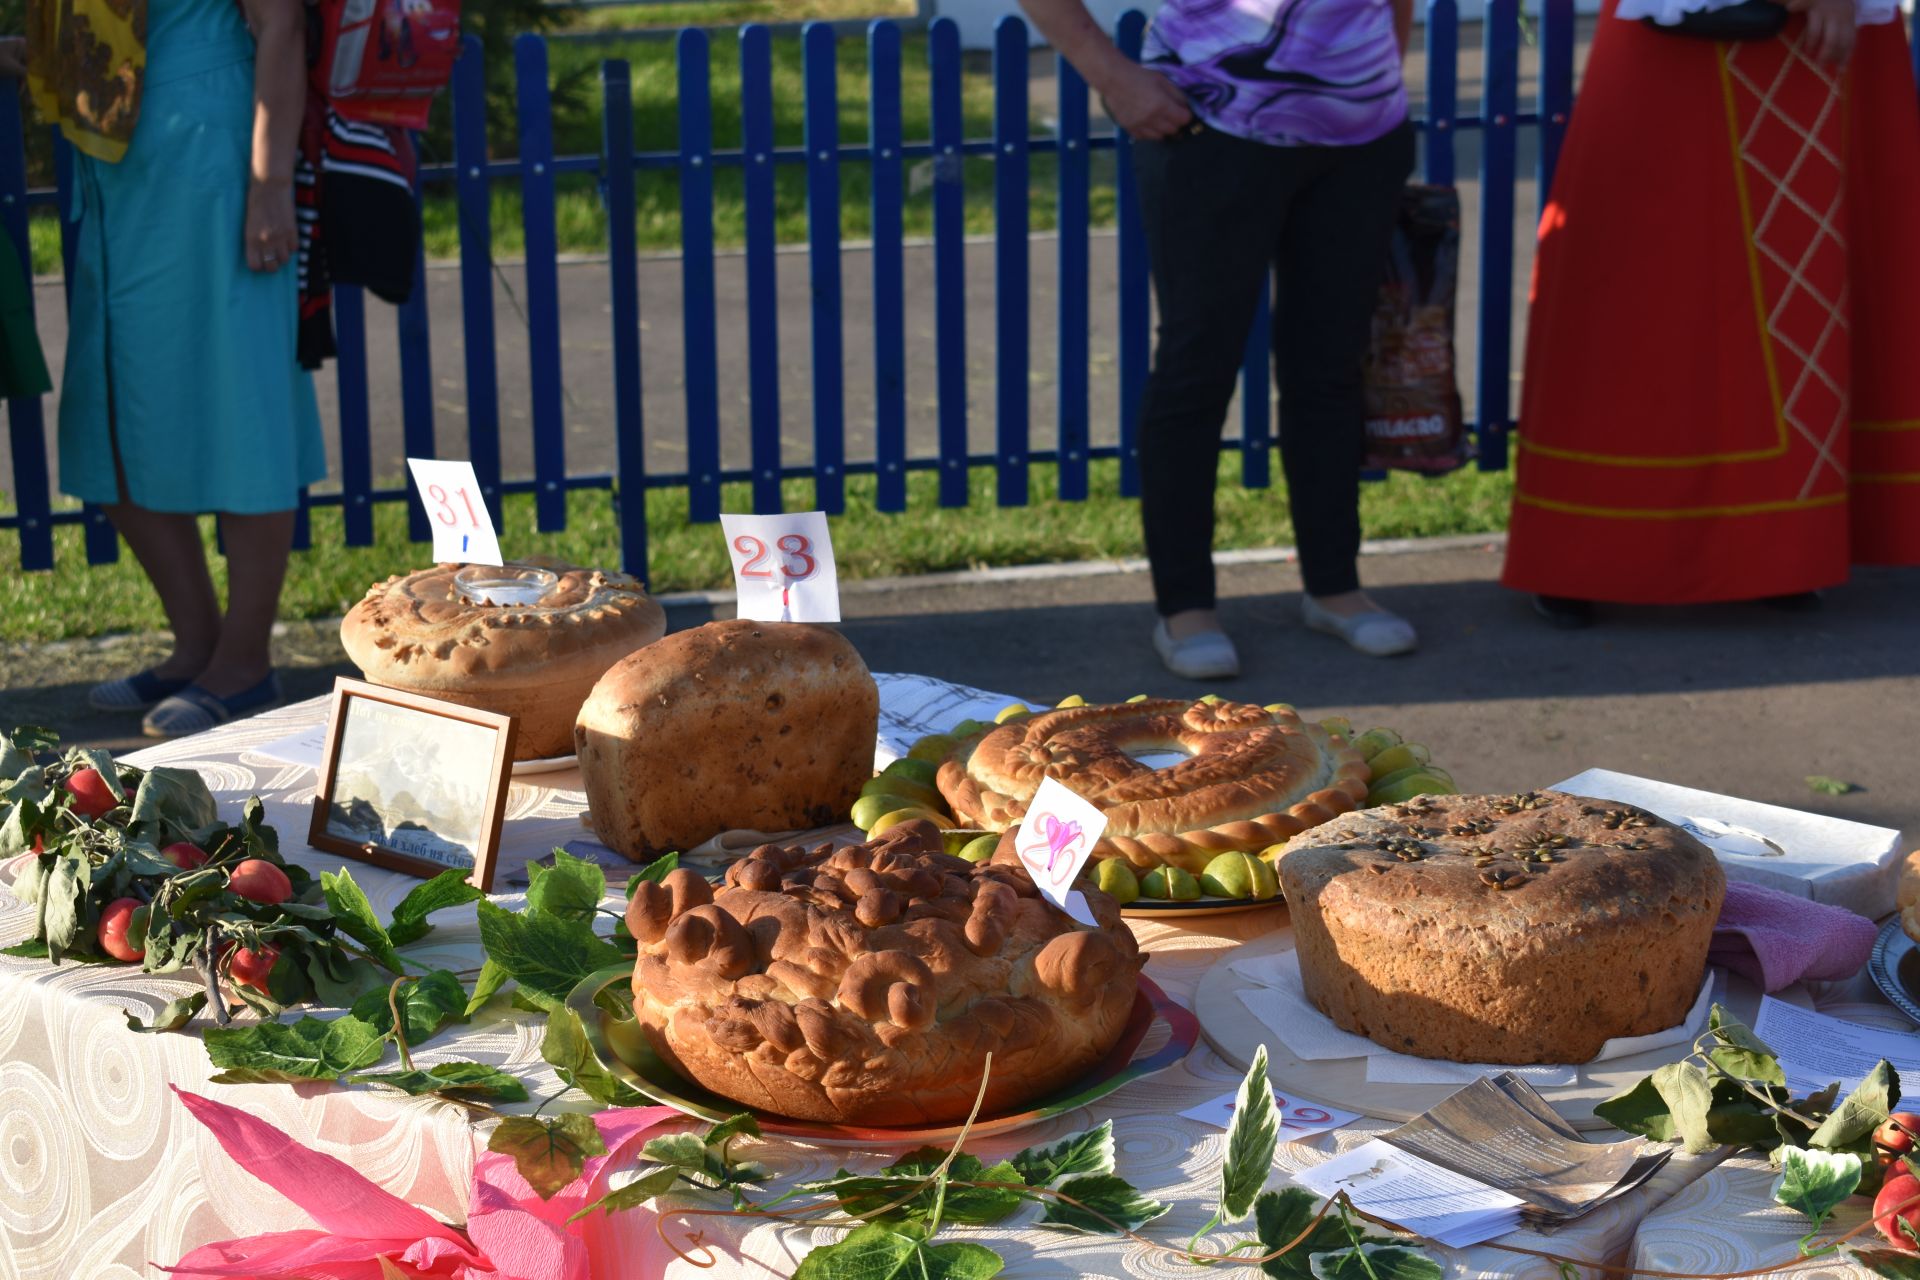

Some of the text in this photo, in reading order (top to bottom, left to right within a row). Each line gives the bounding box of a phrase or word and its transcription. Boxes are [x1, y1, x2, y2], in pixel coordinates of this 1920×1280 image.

[429, 484, 479, 527] 31
[733, 534, 818, 579] 23
[400, 841, 428, 857] хлеб
[1022, 811, 1086, 886] 26
